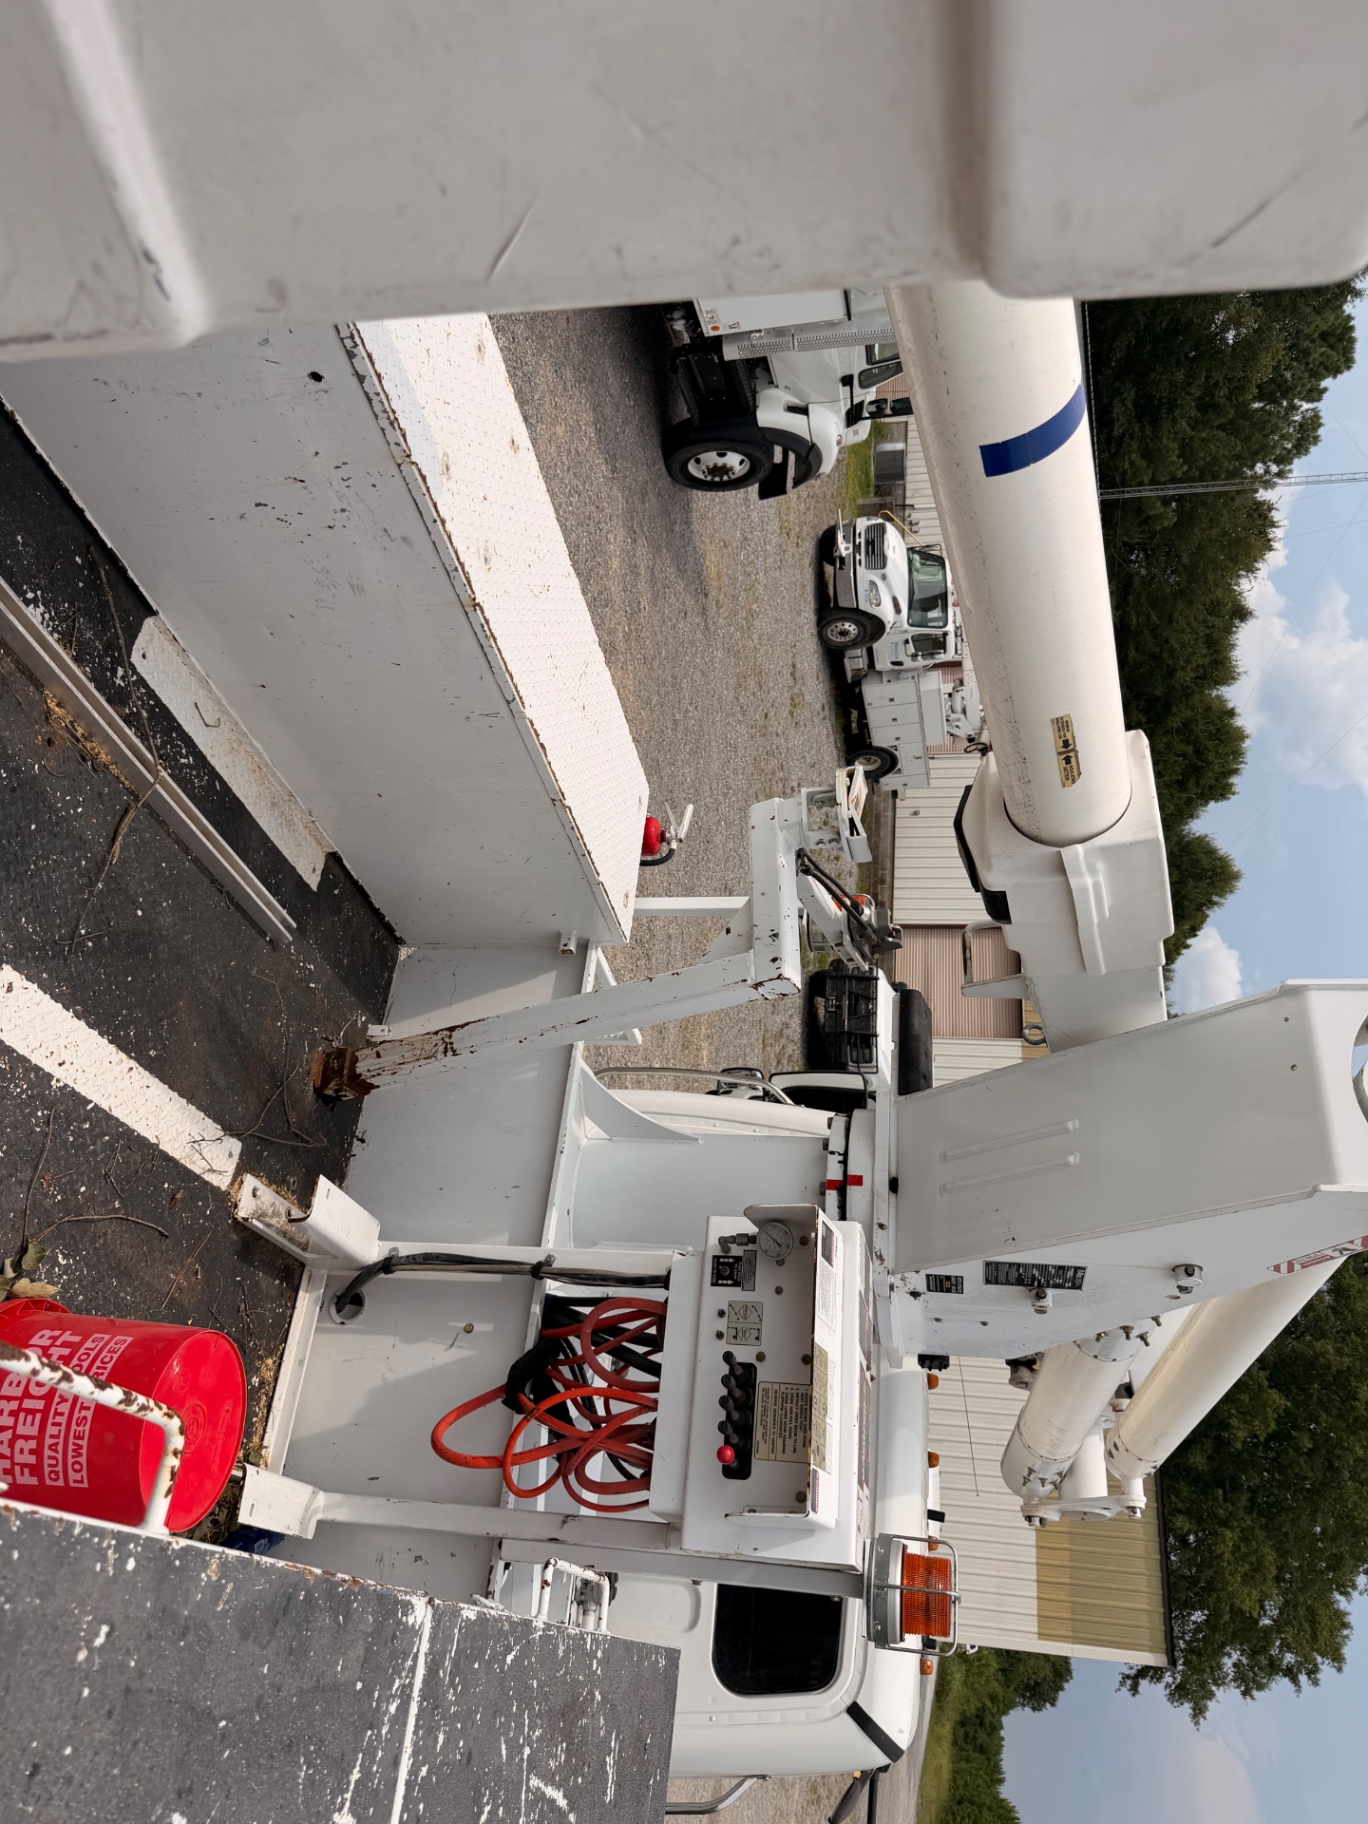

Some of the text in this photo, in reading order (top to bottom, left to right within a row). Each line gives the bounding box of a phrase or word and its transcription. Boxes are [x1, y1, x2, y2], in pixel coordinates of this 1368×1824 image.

[0, 1329, 62, 1483] HARBR
[47, 1393, 69, 1482] QUALITY
[71, 1402, 91, 1484] LOWEST
